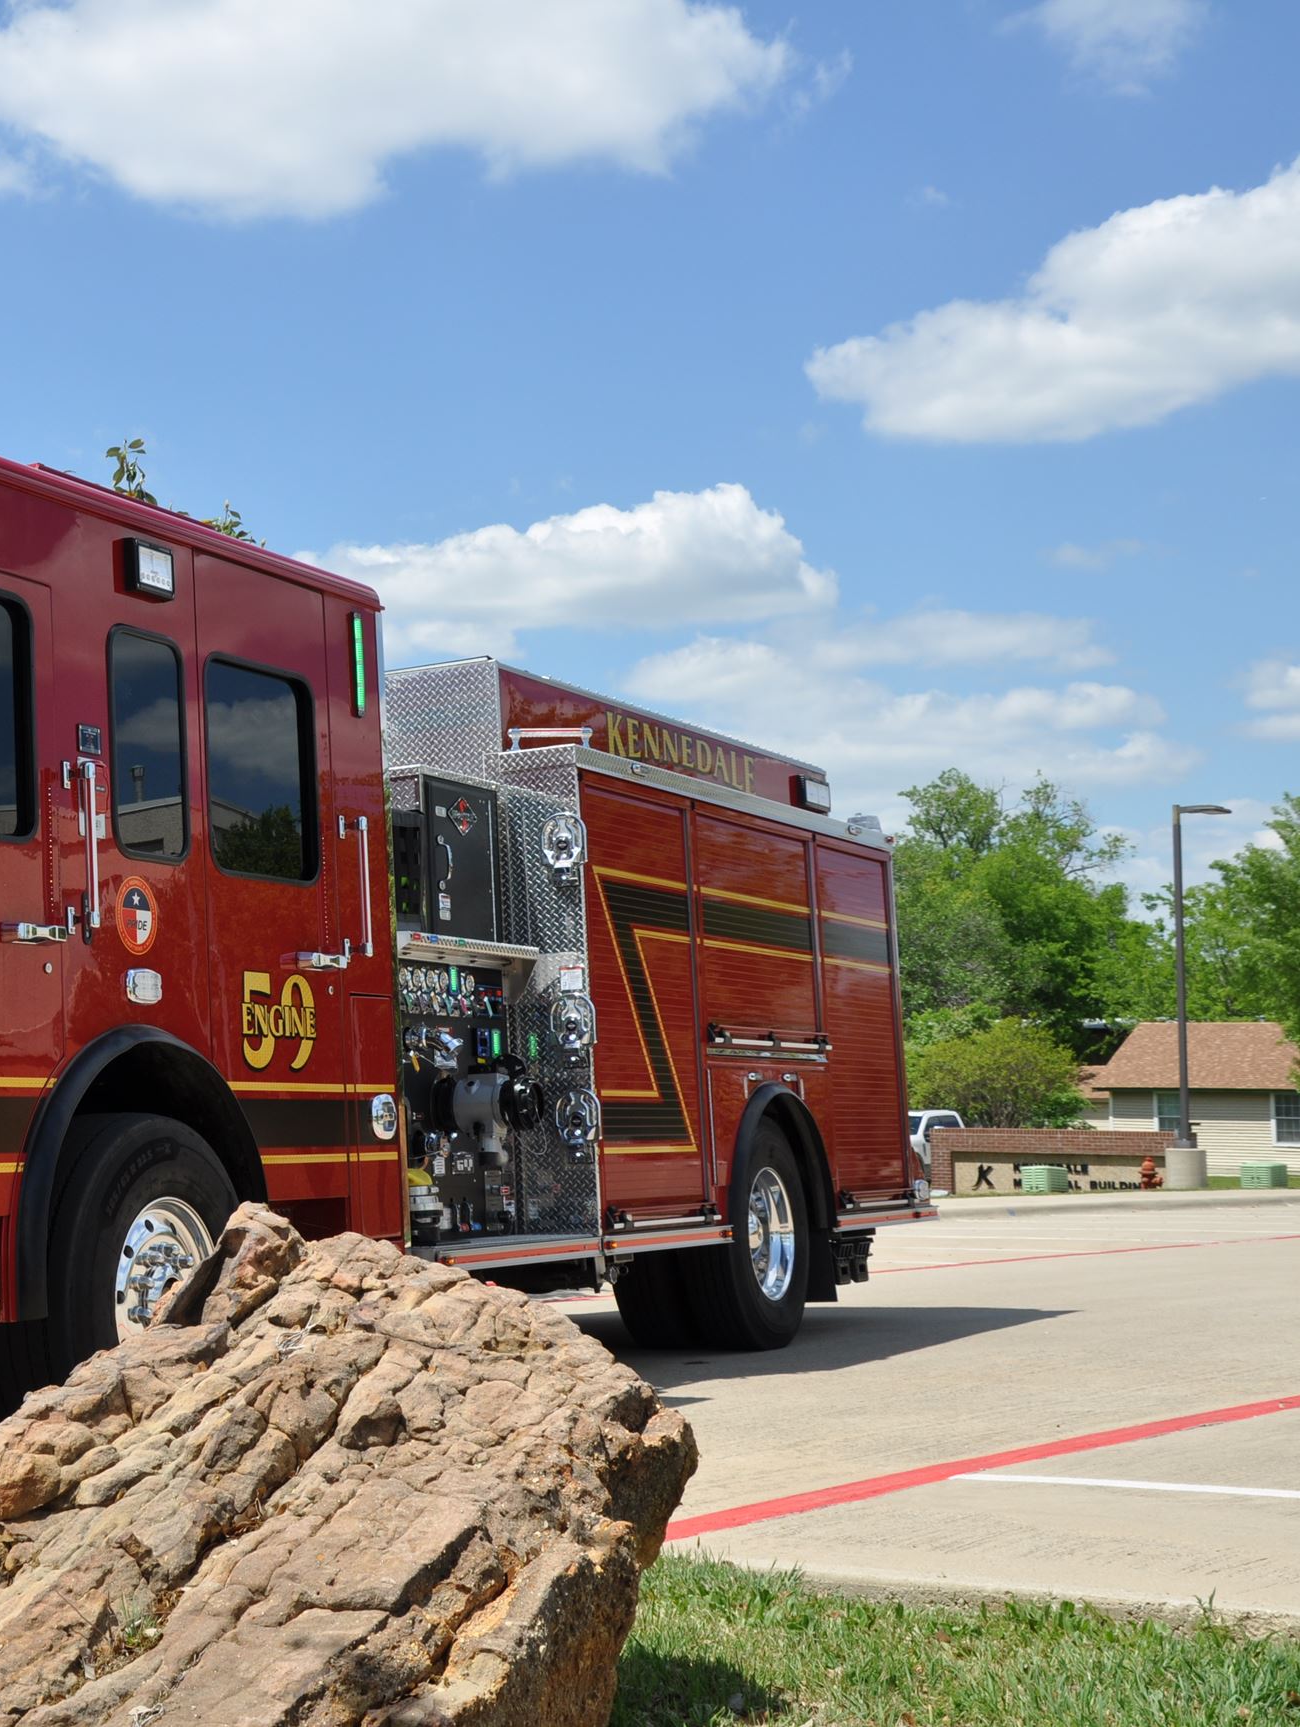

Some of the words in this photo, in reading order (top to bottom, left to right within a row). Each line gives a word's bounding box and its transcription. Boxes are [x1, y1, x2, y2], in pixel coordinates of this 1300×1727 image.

[606, 711, 756, 795] KENNEDALE
[241, 1002, 317, 1039] ENGINE
[243, 970, 315, 1070] 59
[1089, 1179, 1141, 1191] BUILDIN
